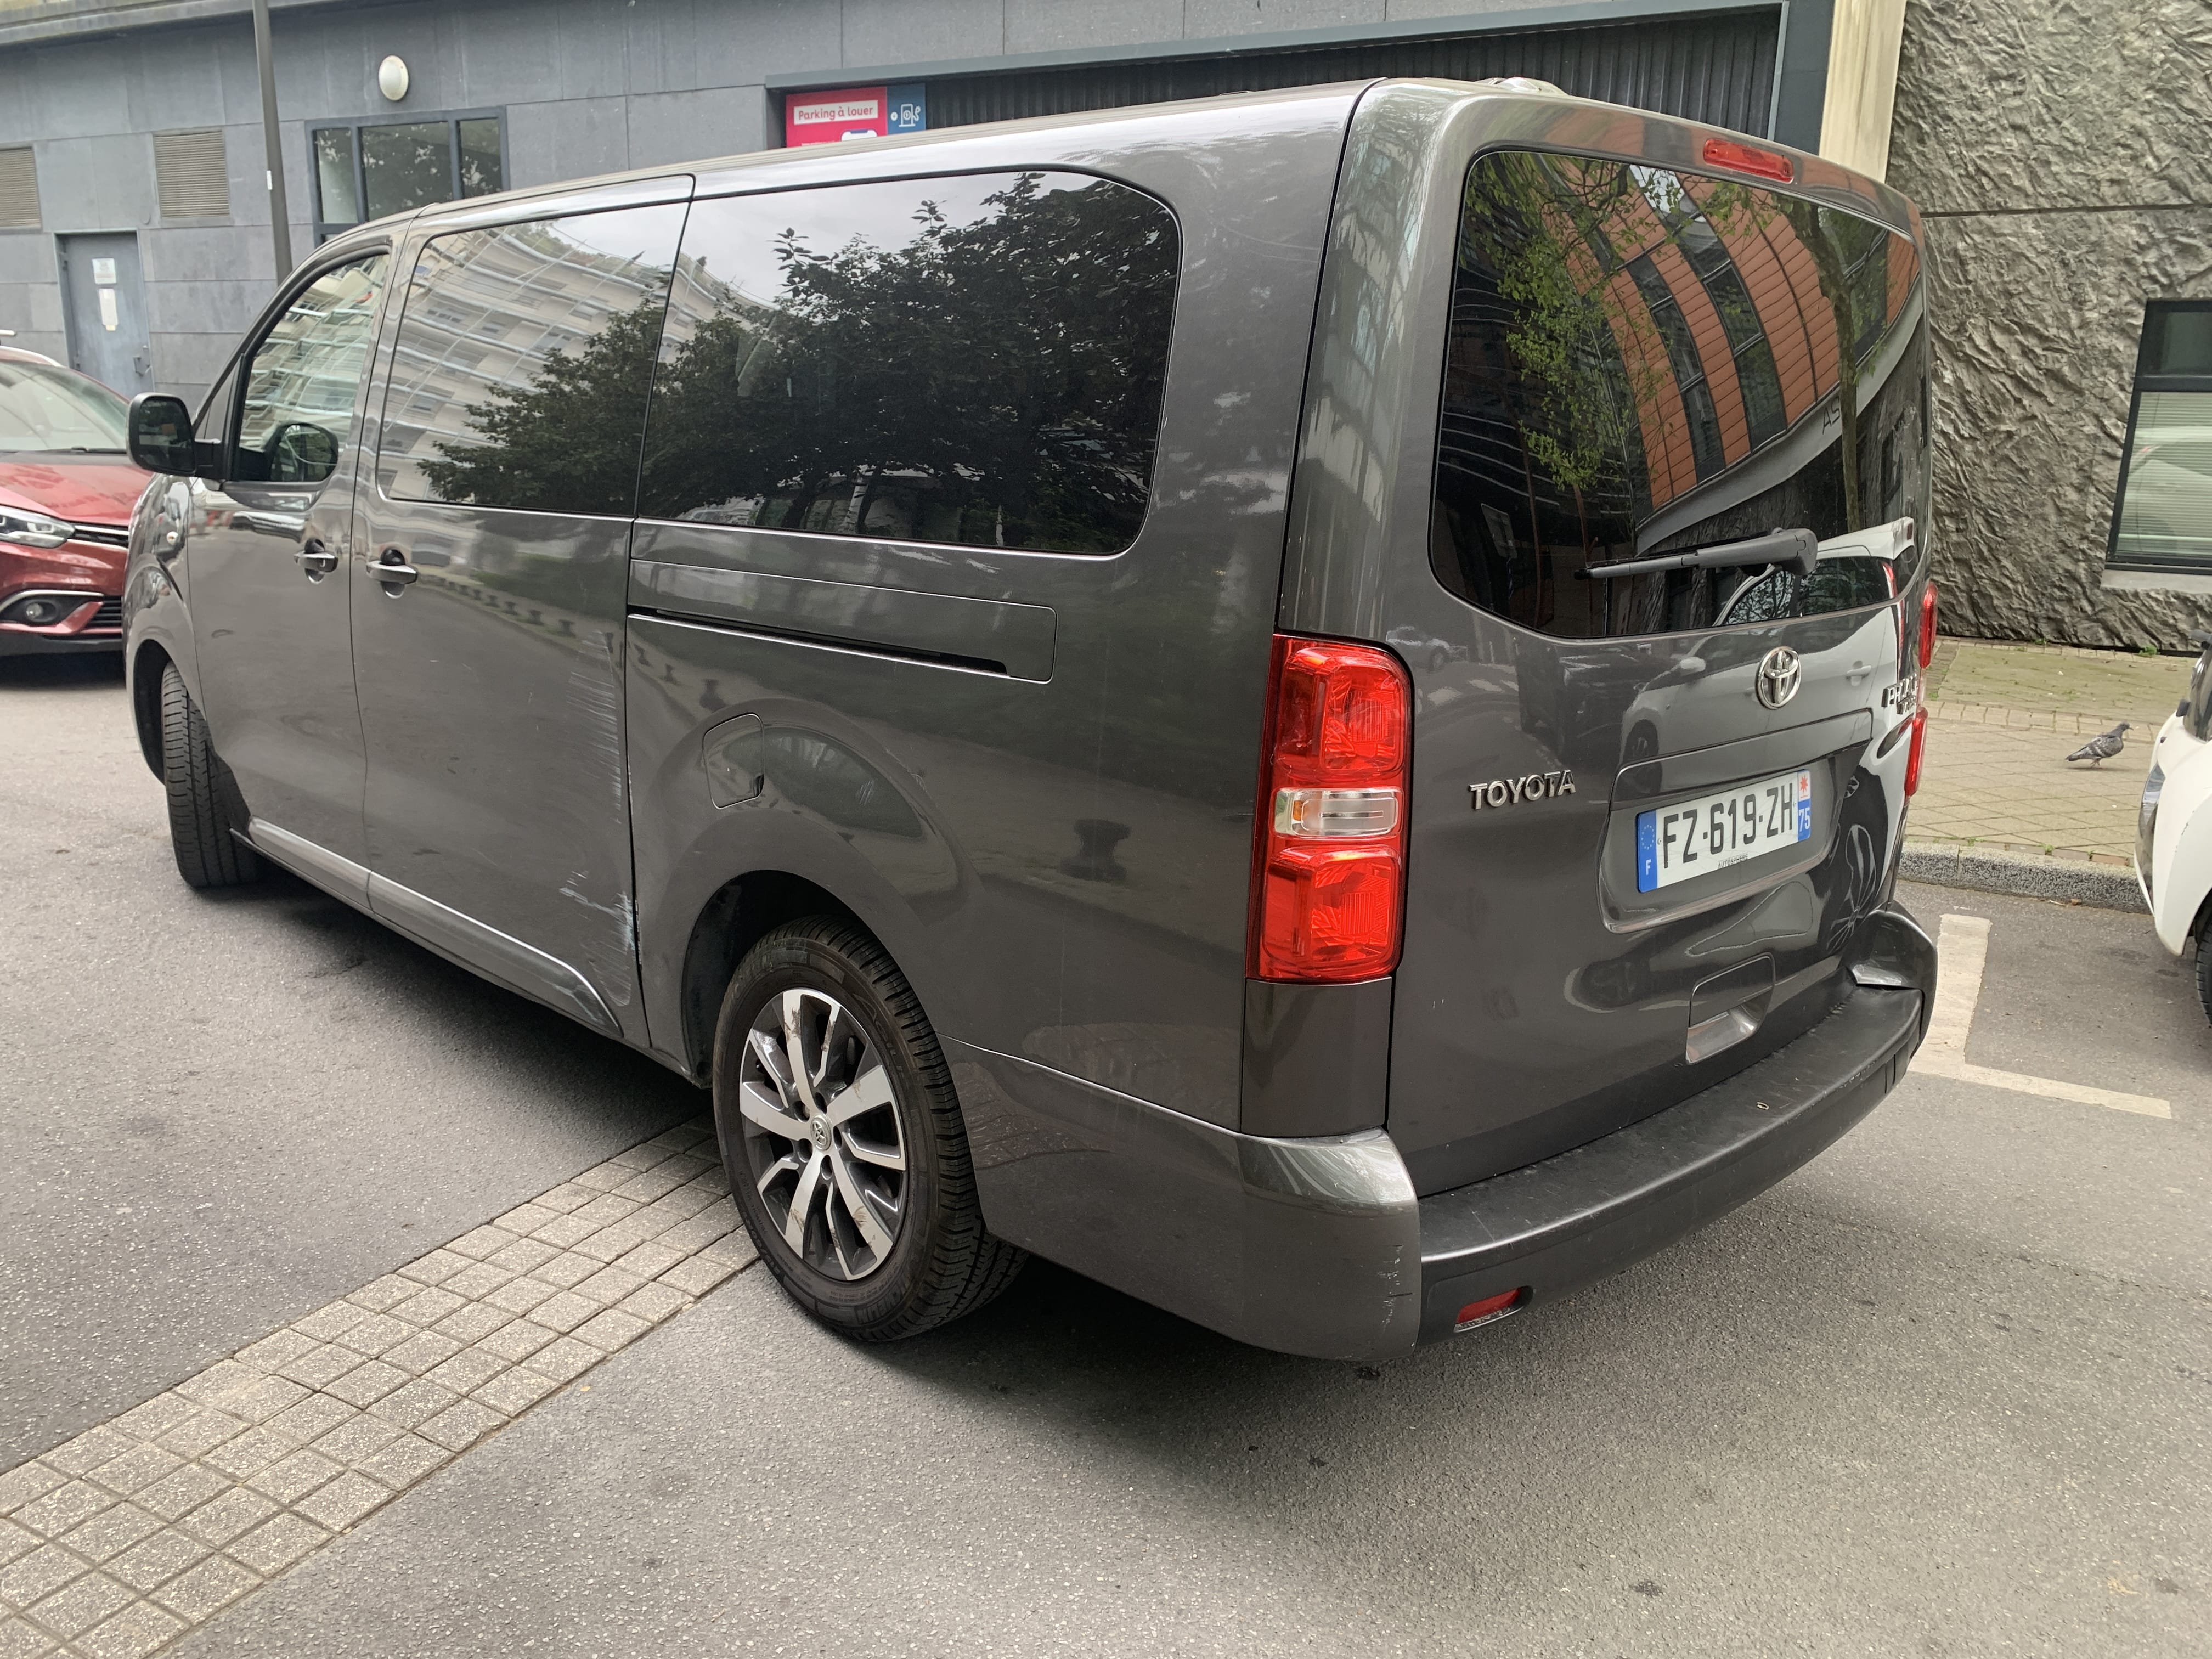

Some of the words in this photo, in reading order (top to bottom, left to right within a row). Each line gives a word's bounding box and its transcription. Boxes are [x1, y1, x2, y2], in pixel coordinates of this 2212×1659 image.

[798, 109, 835, 120] Parking
[838, 106, 844, 117] à
[848, 106, 873, 116] louer
[1468, 769, 1576, 810] TOYOTA
[1663, 783, 1793, 868] FZ-619-ZH
[1798, 807, 1810, 832] 75
[1646, 859, 1651, 876] F
